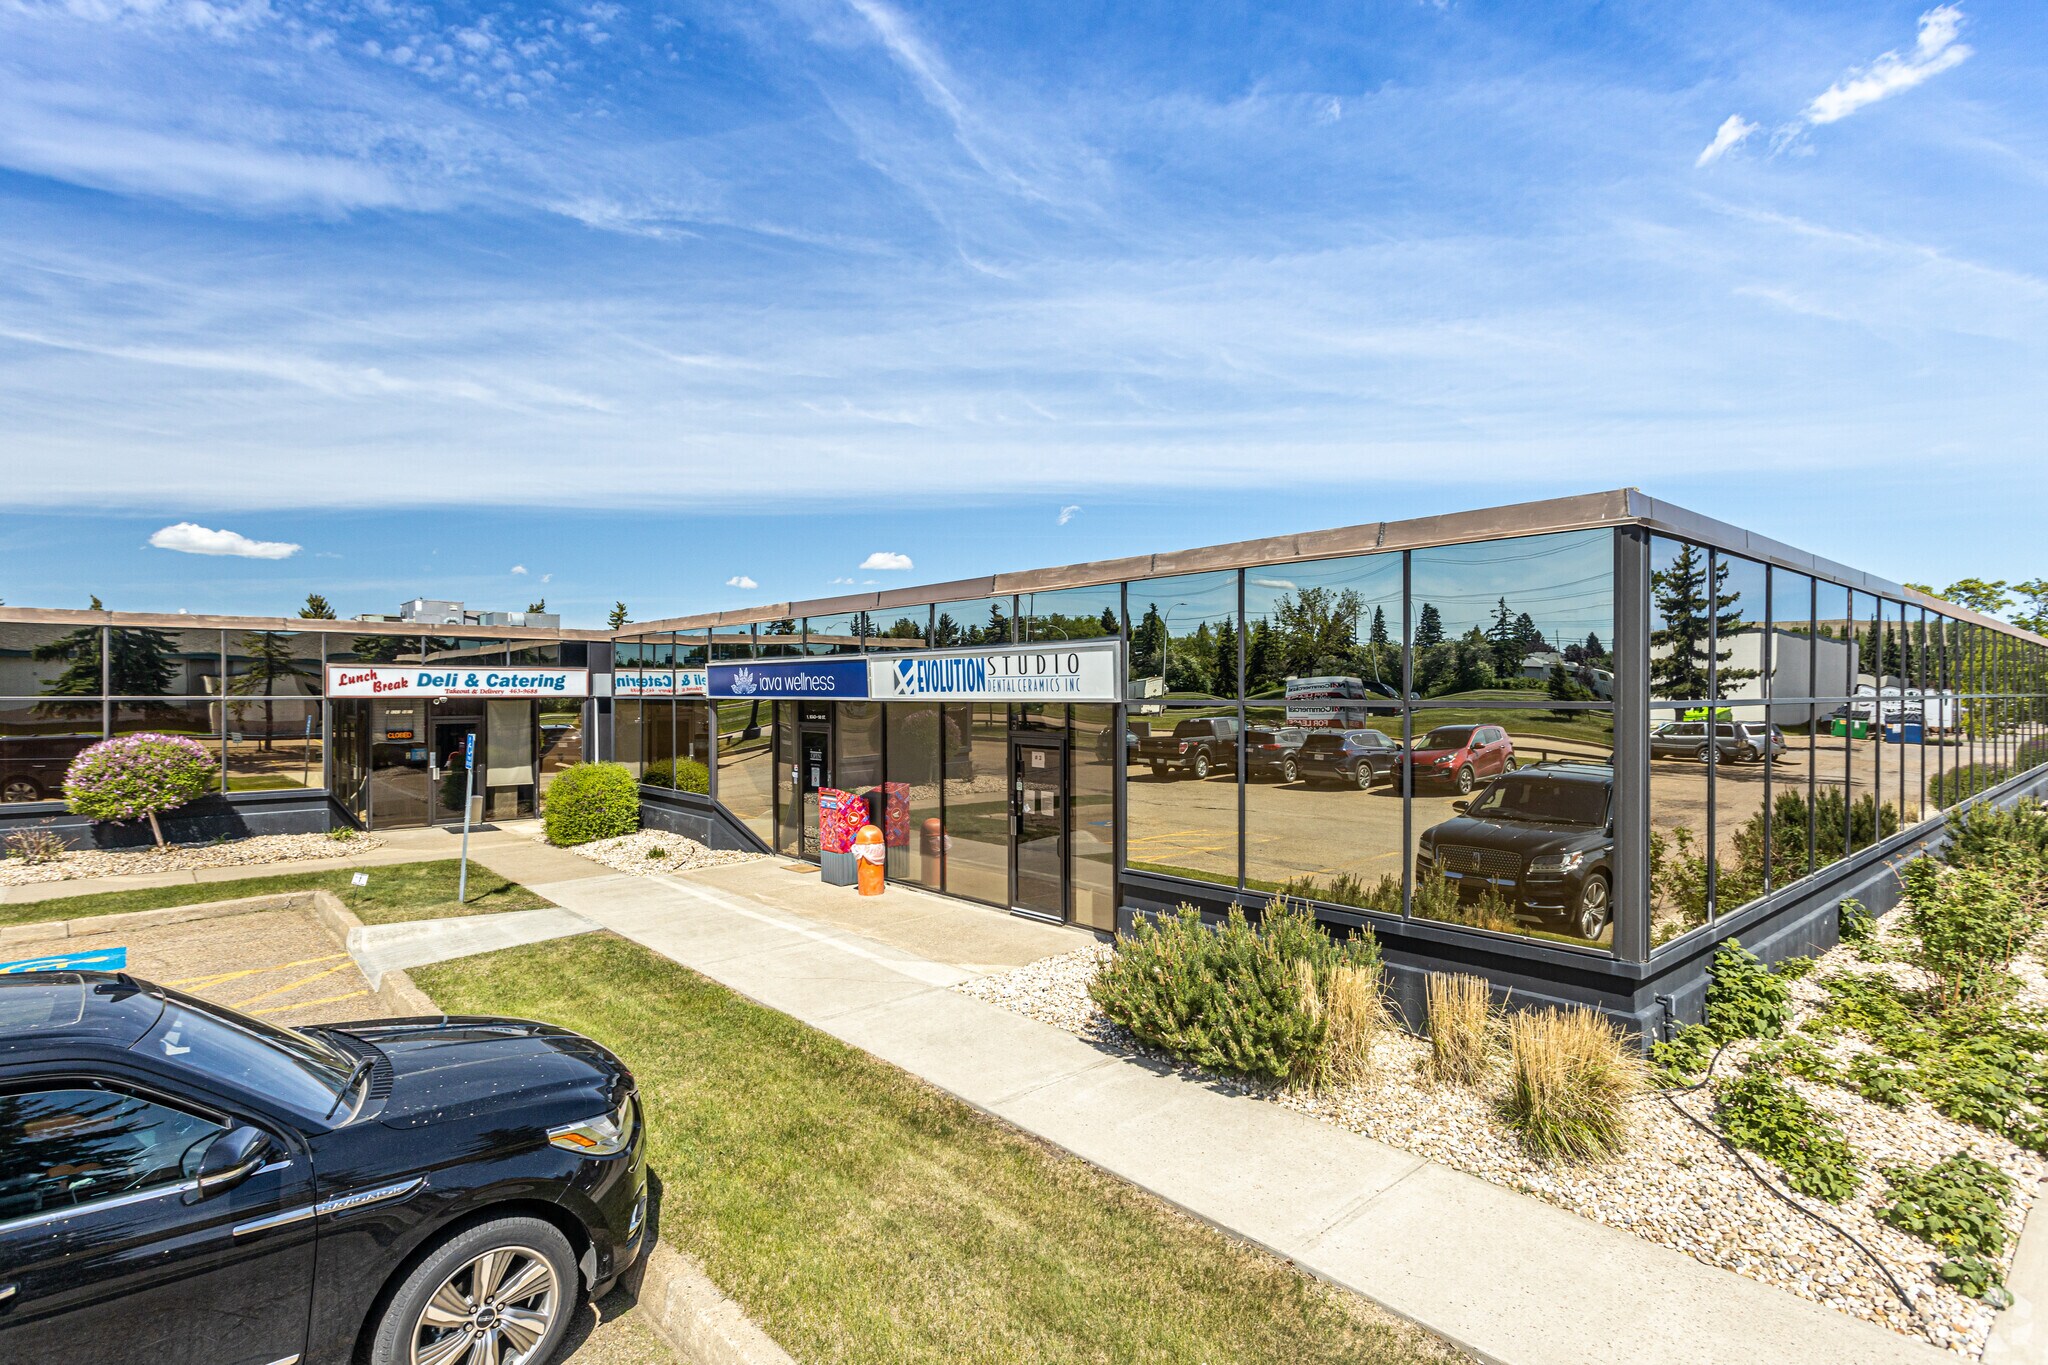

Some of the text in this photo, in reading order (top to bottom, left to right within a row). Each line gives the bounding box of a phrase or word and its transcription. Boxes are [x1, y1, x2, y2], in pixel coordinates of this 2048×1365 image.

[339, 669, 377, 686] Lunch
[784, 672, 835, 691] wellness
[917, 653, 1079, 693] EVOLUTION STUDIO
[373, 677, 409, 693] Break
[417, 673, 566, 691] Deli & Catering
[1065, 677, 1080, 692] INC
